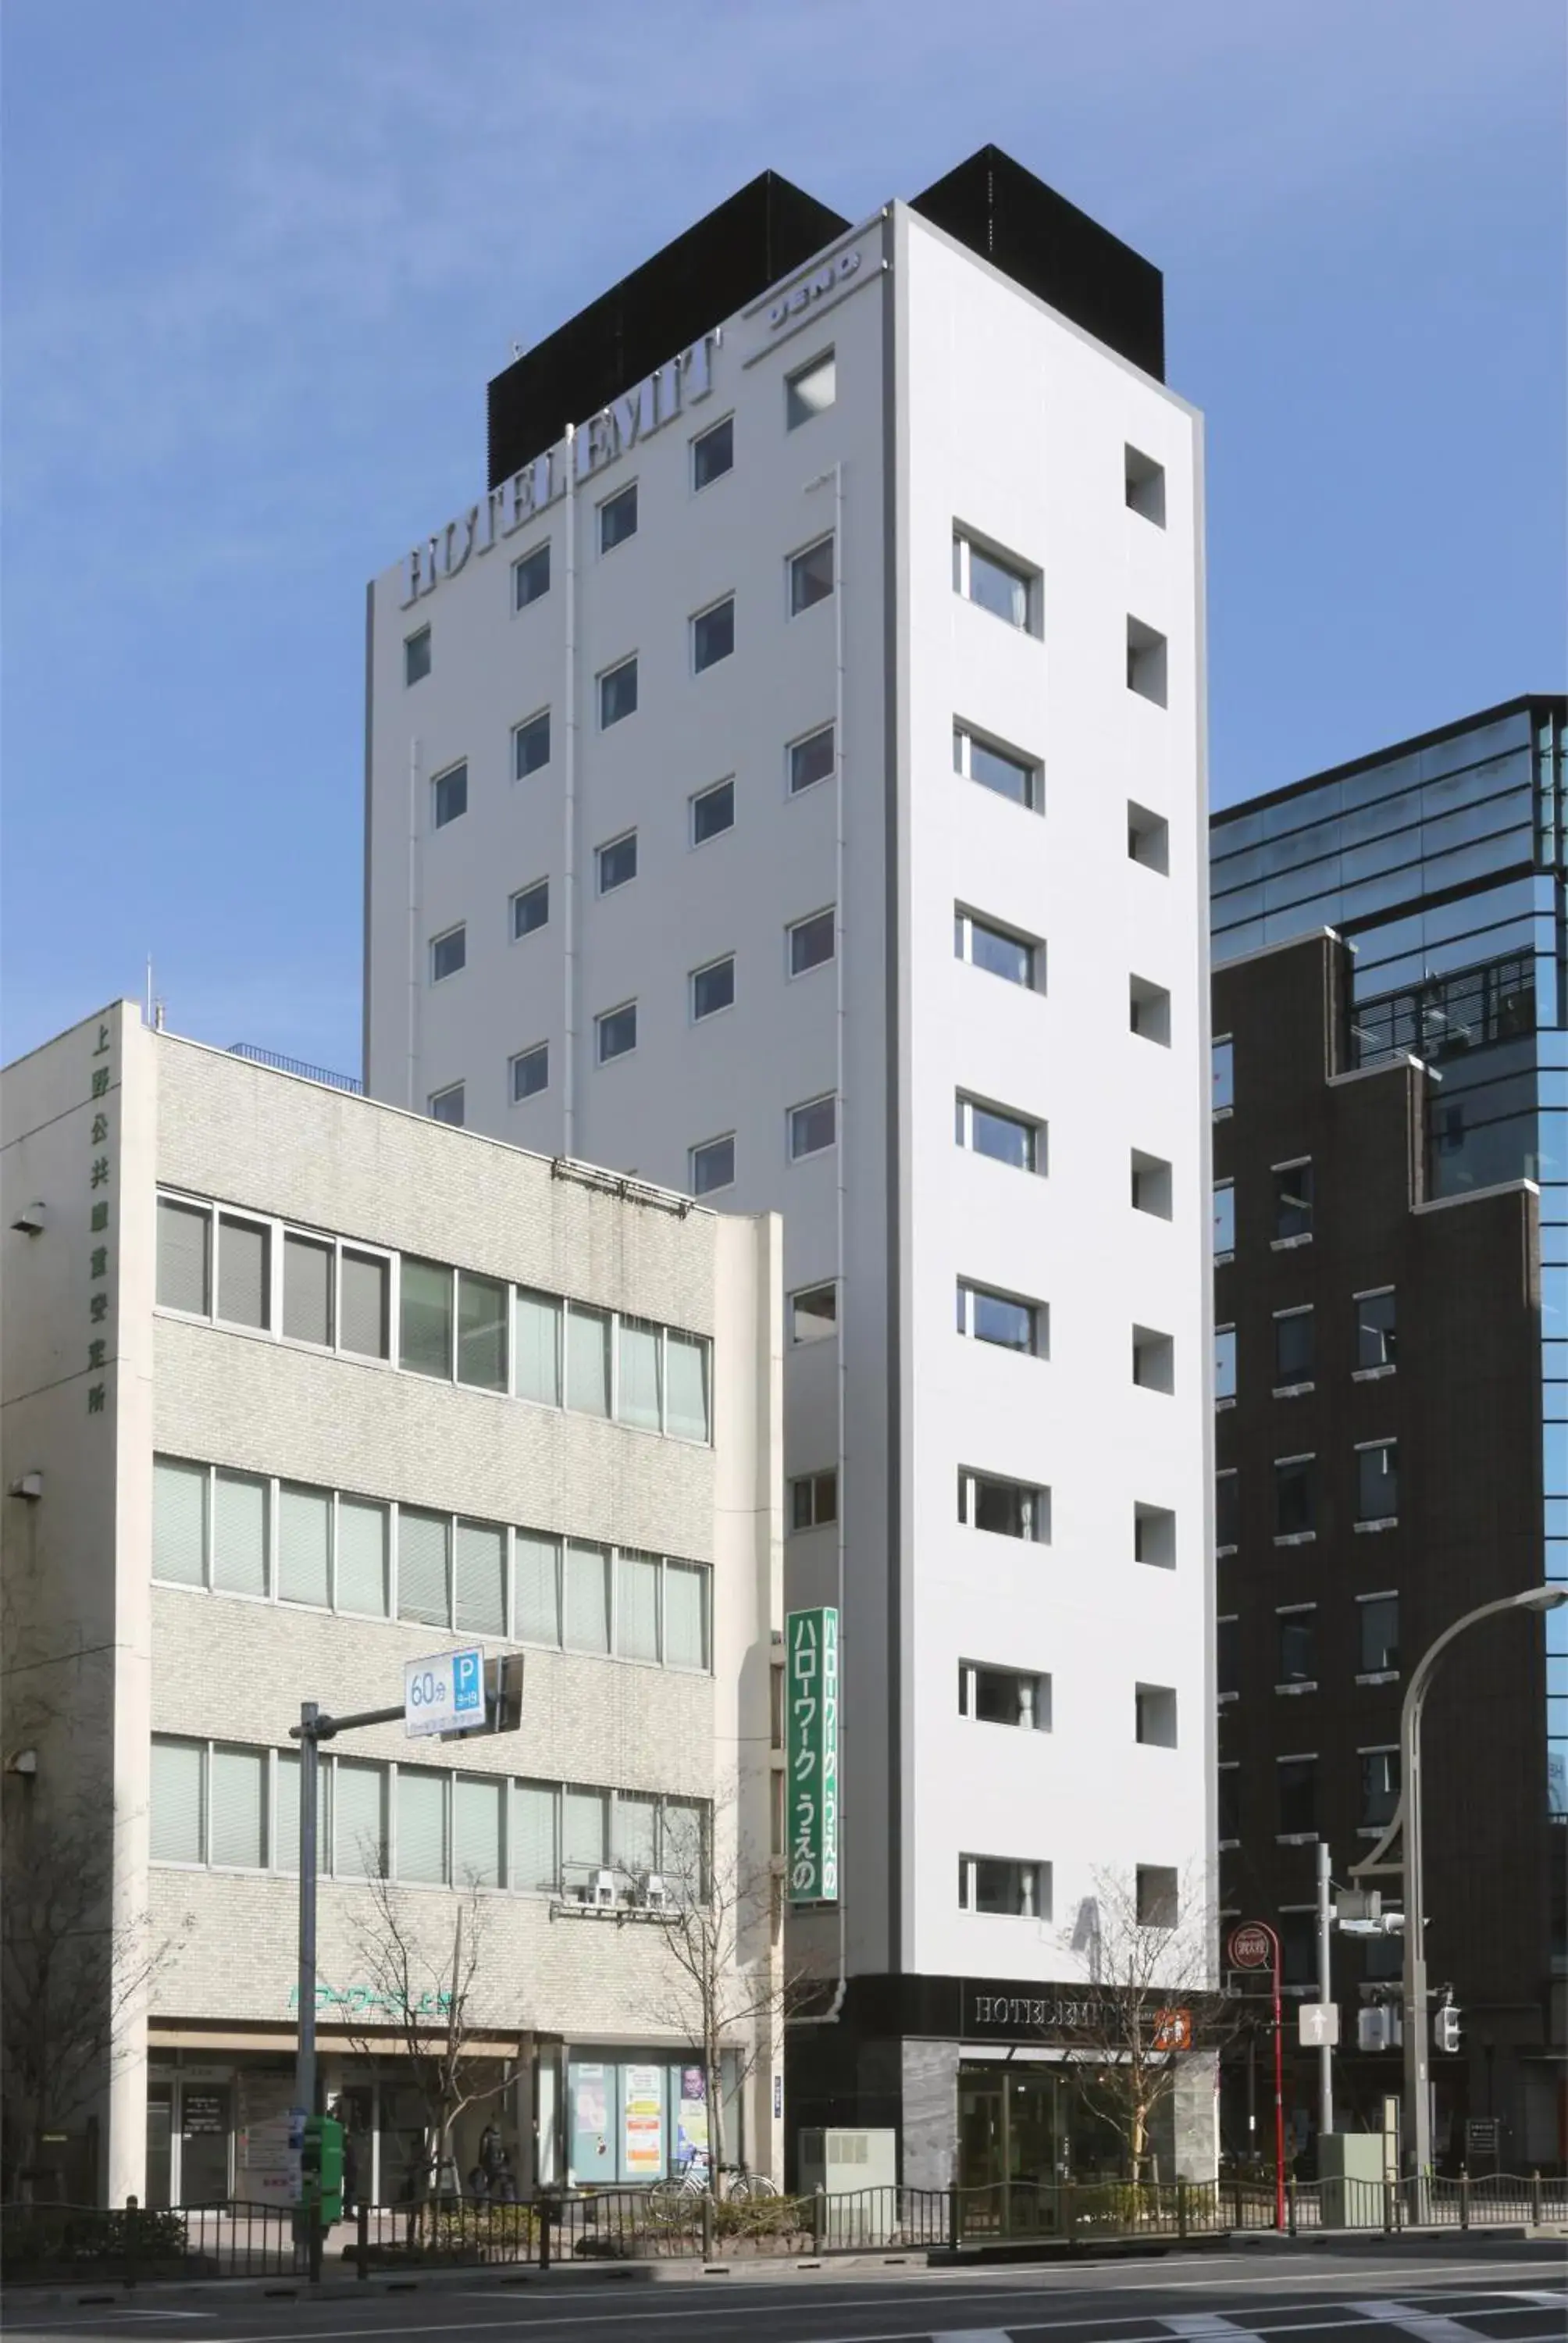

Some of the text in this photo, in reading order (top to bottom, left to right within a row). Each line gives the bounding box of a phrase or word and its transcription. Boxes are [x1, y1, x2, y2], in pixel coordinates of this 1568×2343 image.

[400, 448, 568, 612] HOTEL
[411, 1672, 446, 1706] 60分
[461, 1659, 473, 1692] P
[793, 1619, 816, 1890] ハローワーク うえの
[825, 1618, 837, 1890] ハローワーク うえの
[975, 1997, 1056, 2024] HOTEL
